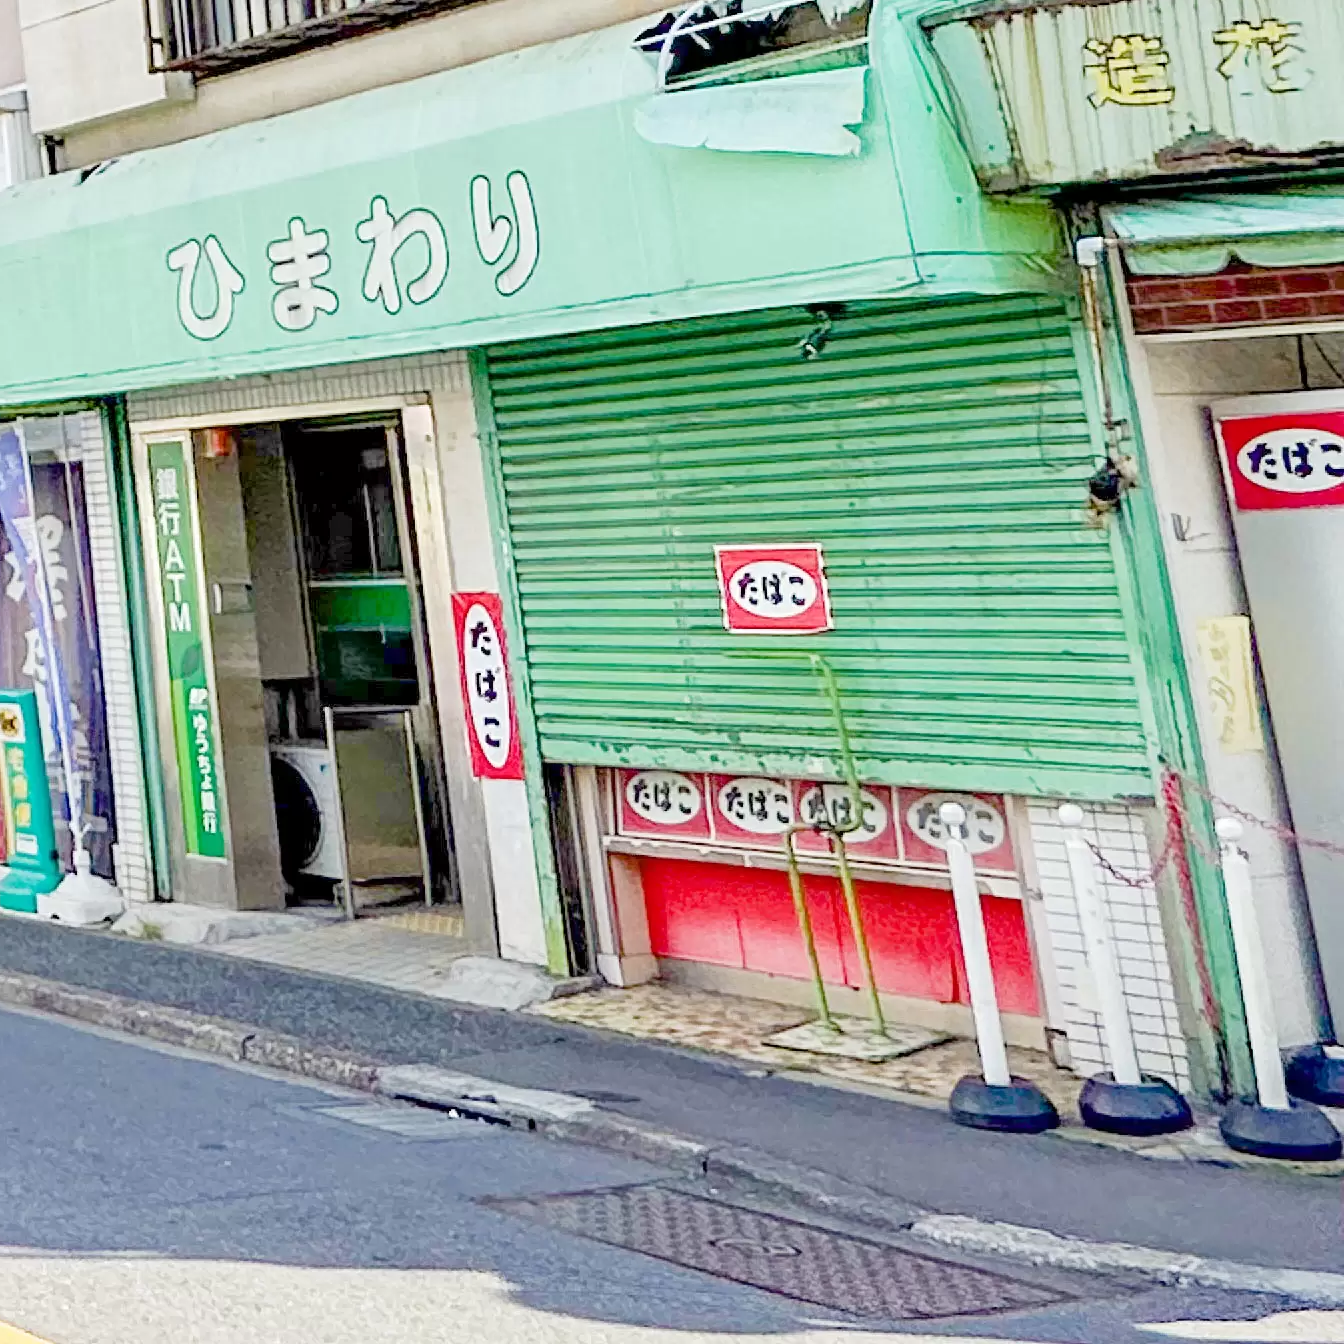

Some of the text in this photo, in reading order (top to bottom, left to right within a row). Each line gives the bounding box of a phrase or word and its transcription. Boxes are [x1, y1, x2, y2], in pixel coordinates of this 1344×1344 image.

[165, 169, 542, 342] ひまわり
[1246, 437, 1344, 481] たばこ
[156, 467, 193, 634] 銀行ATM
[736, 569, 806, 607] たばこ
[469, 619, 502, 749] たばこ
[631, 777, 693, 815] たばこ
[724, 785, 791, 824] たばこ
